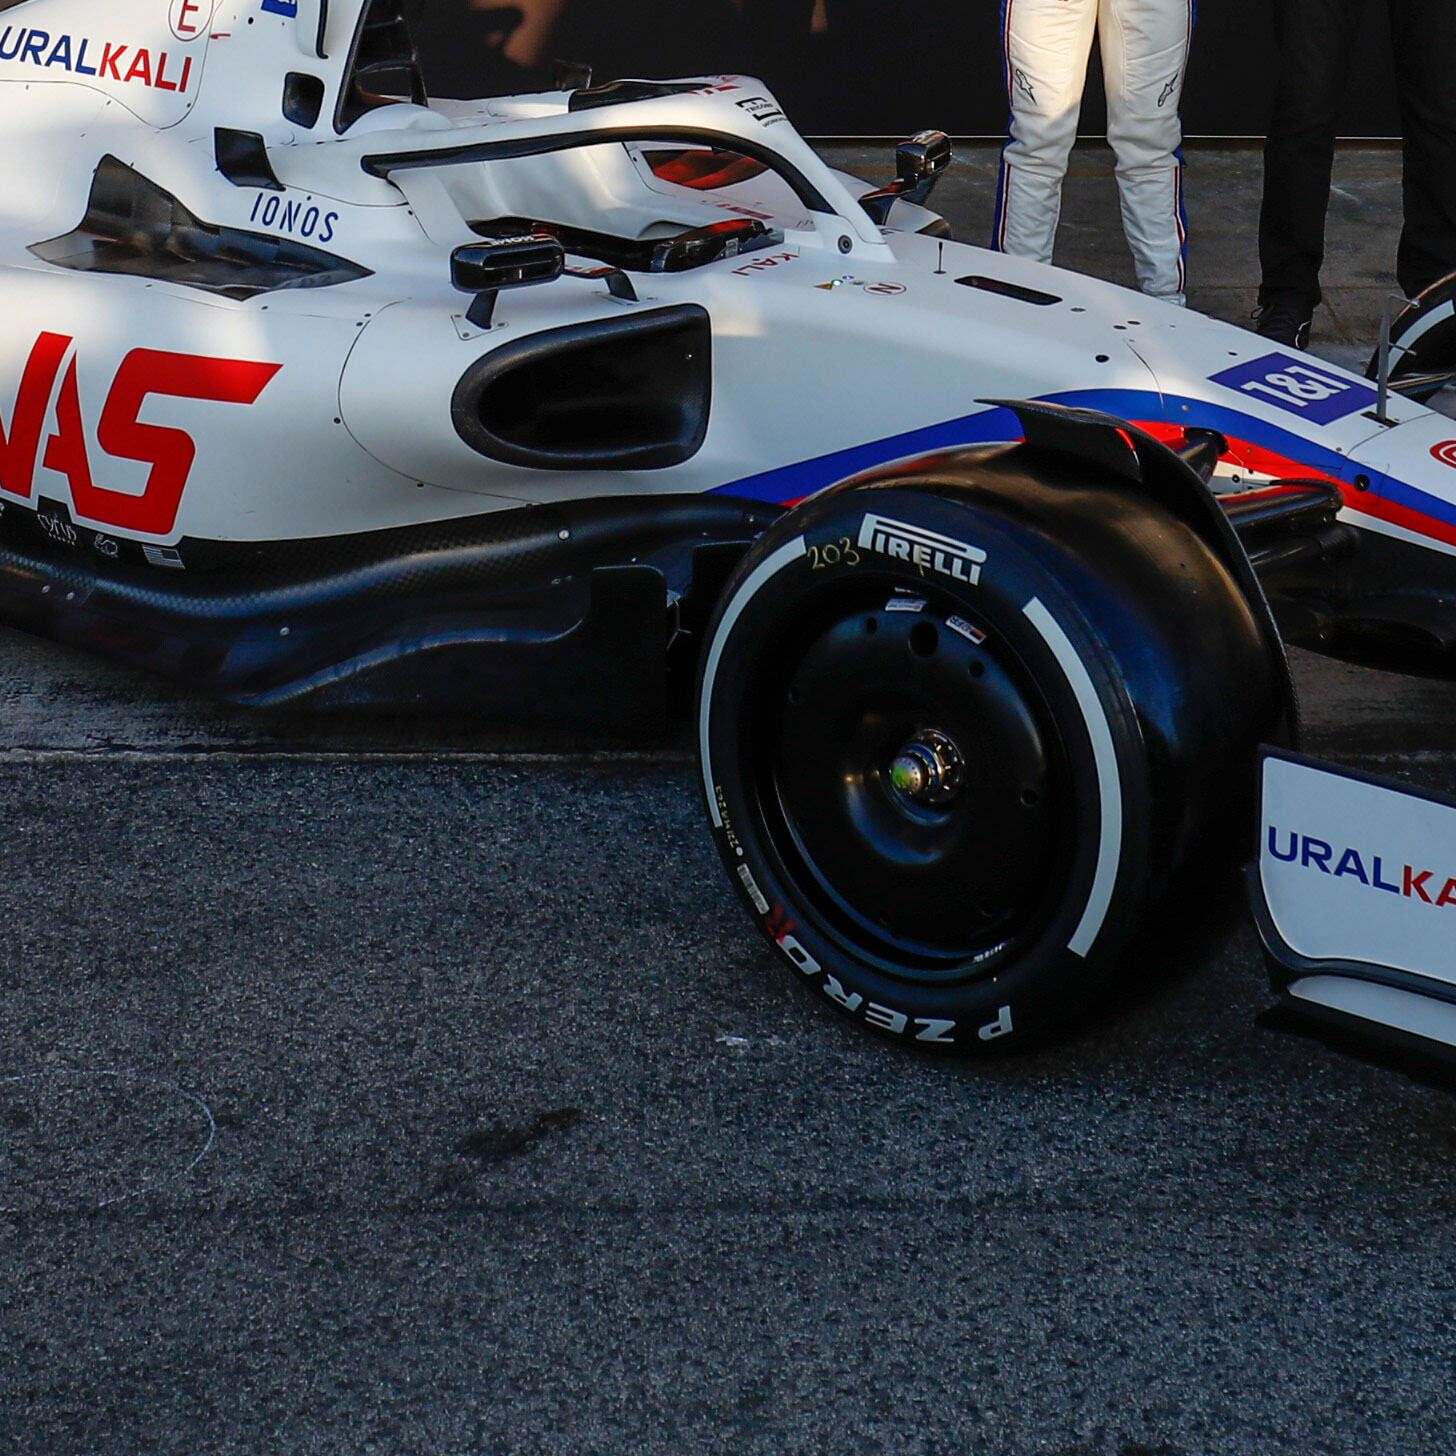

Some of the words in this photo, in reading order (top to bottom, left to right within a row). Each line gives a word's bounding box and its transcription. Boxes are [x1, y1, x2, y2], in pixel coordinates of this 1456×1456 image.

[250, 192, 340, 243] IONOS
[1239, 364, 1352, 408] 1&1
[858, 512, 987, 585] PIRELLI
[776, 935, 955, 1043] ZERO
[978, 1005, 1013, 1041] P
